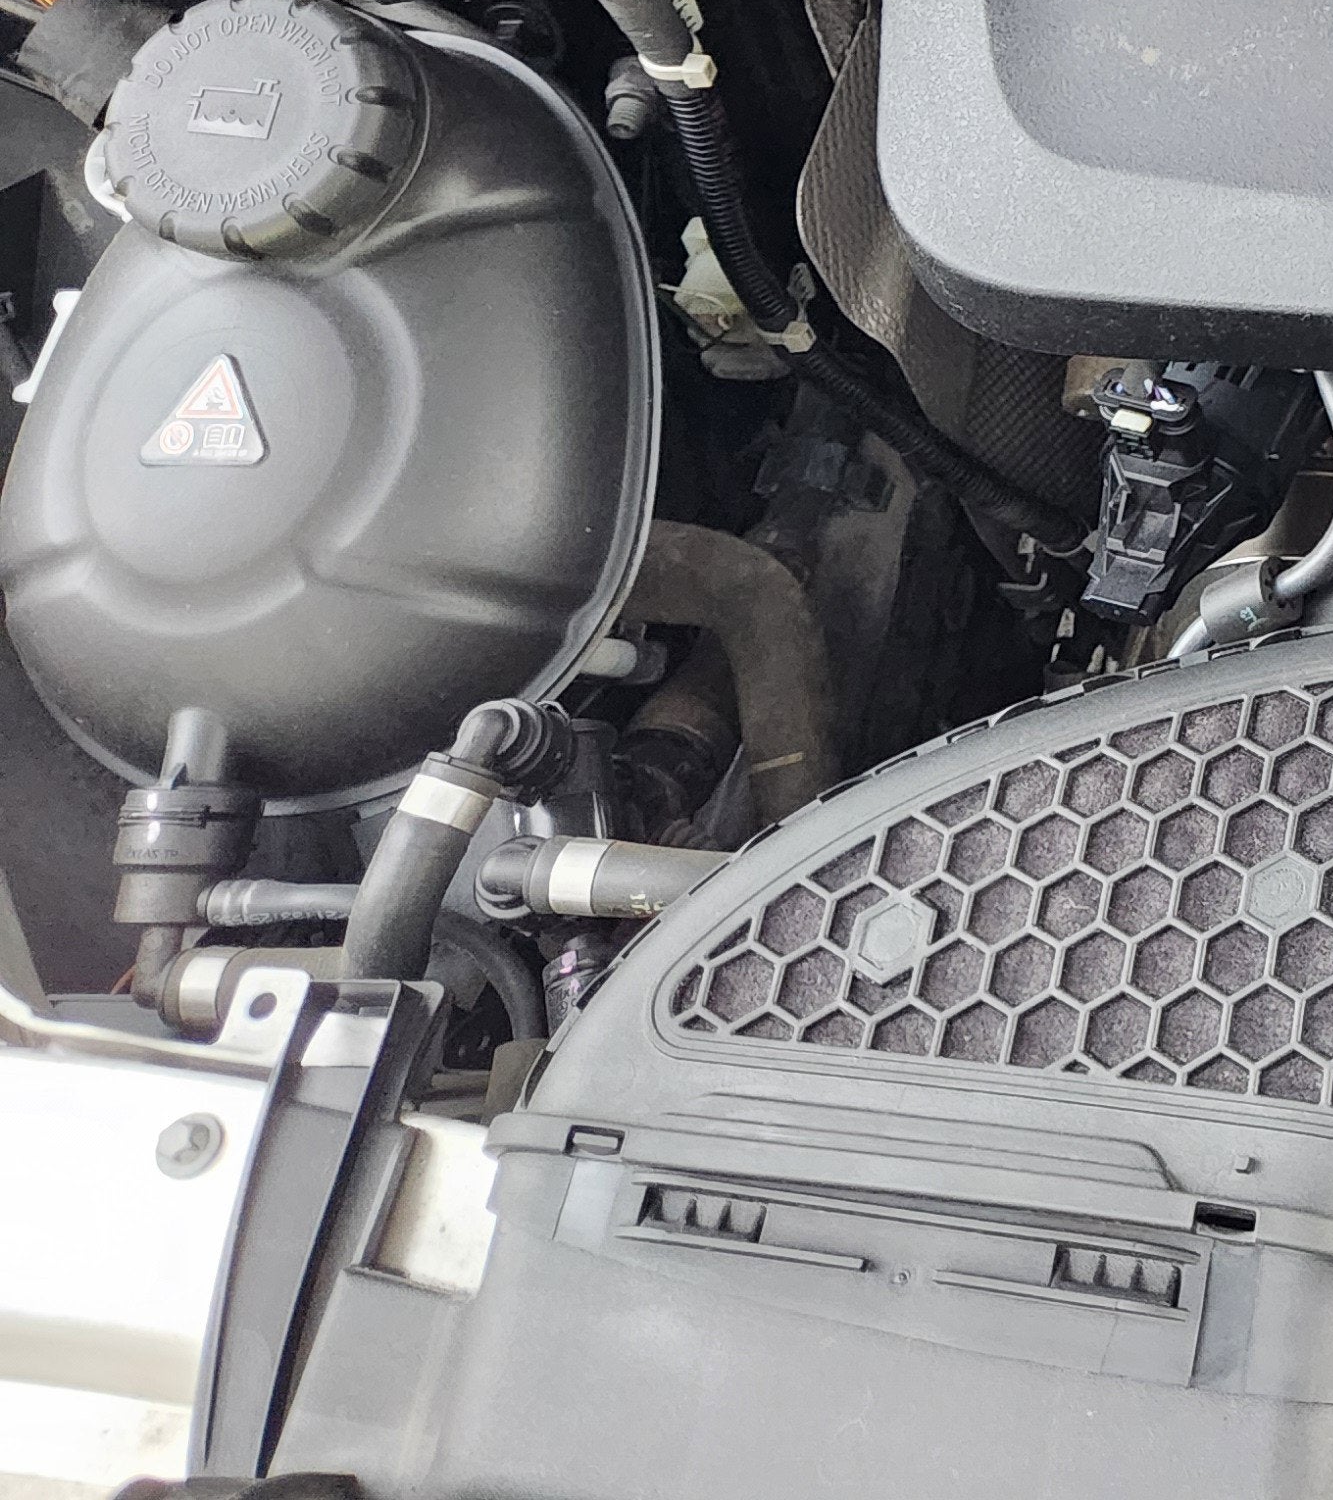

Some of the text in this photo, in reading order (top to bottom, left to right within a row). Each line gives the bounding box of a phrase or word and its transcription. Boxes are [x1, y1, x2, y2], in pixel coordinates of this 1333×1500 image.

[144, 13, 342, 106] DO NOT OPEN WHEN HOT
[127, 112, 157, 171] NICHT
[217, 178, 280, 214] WENN
[279, 131, 330, 188] HEISS
